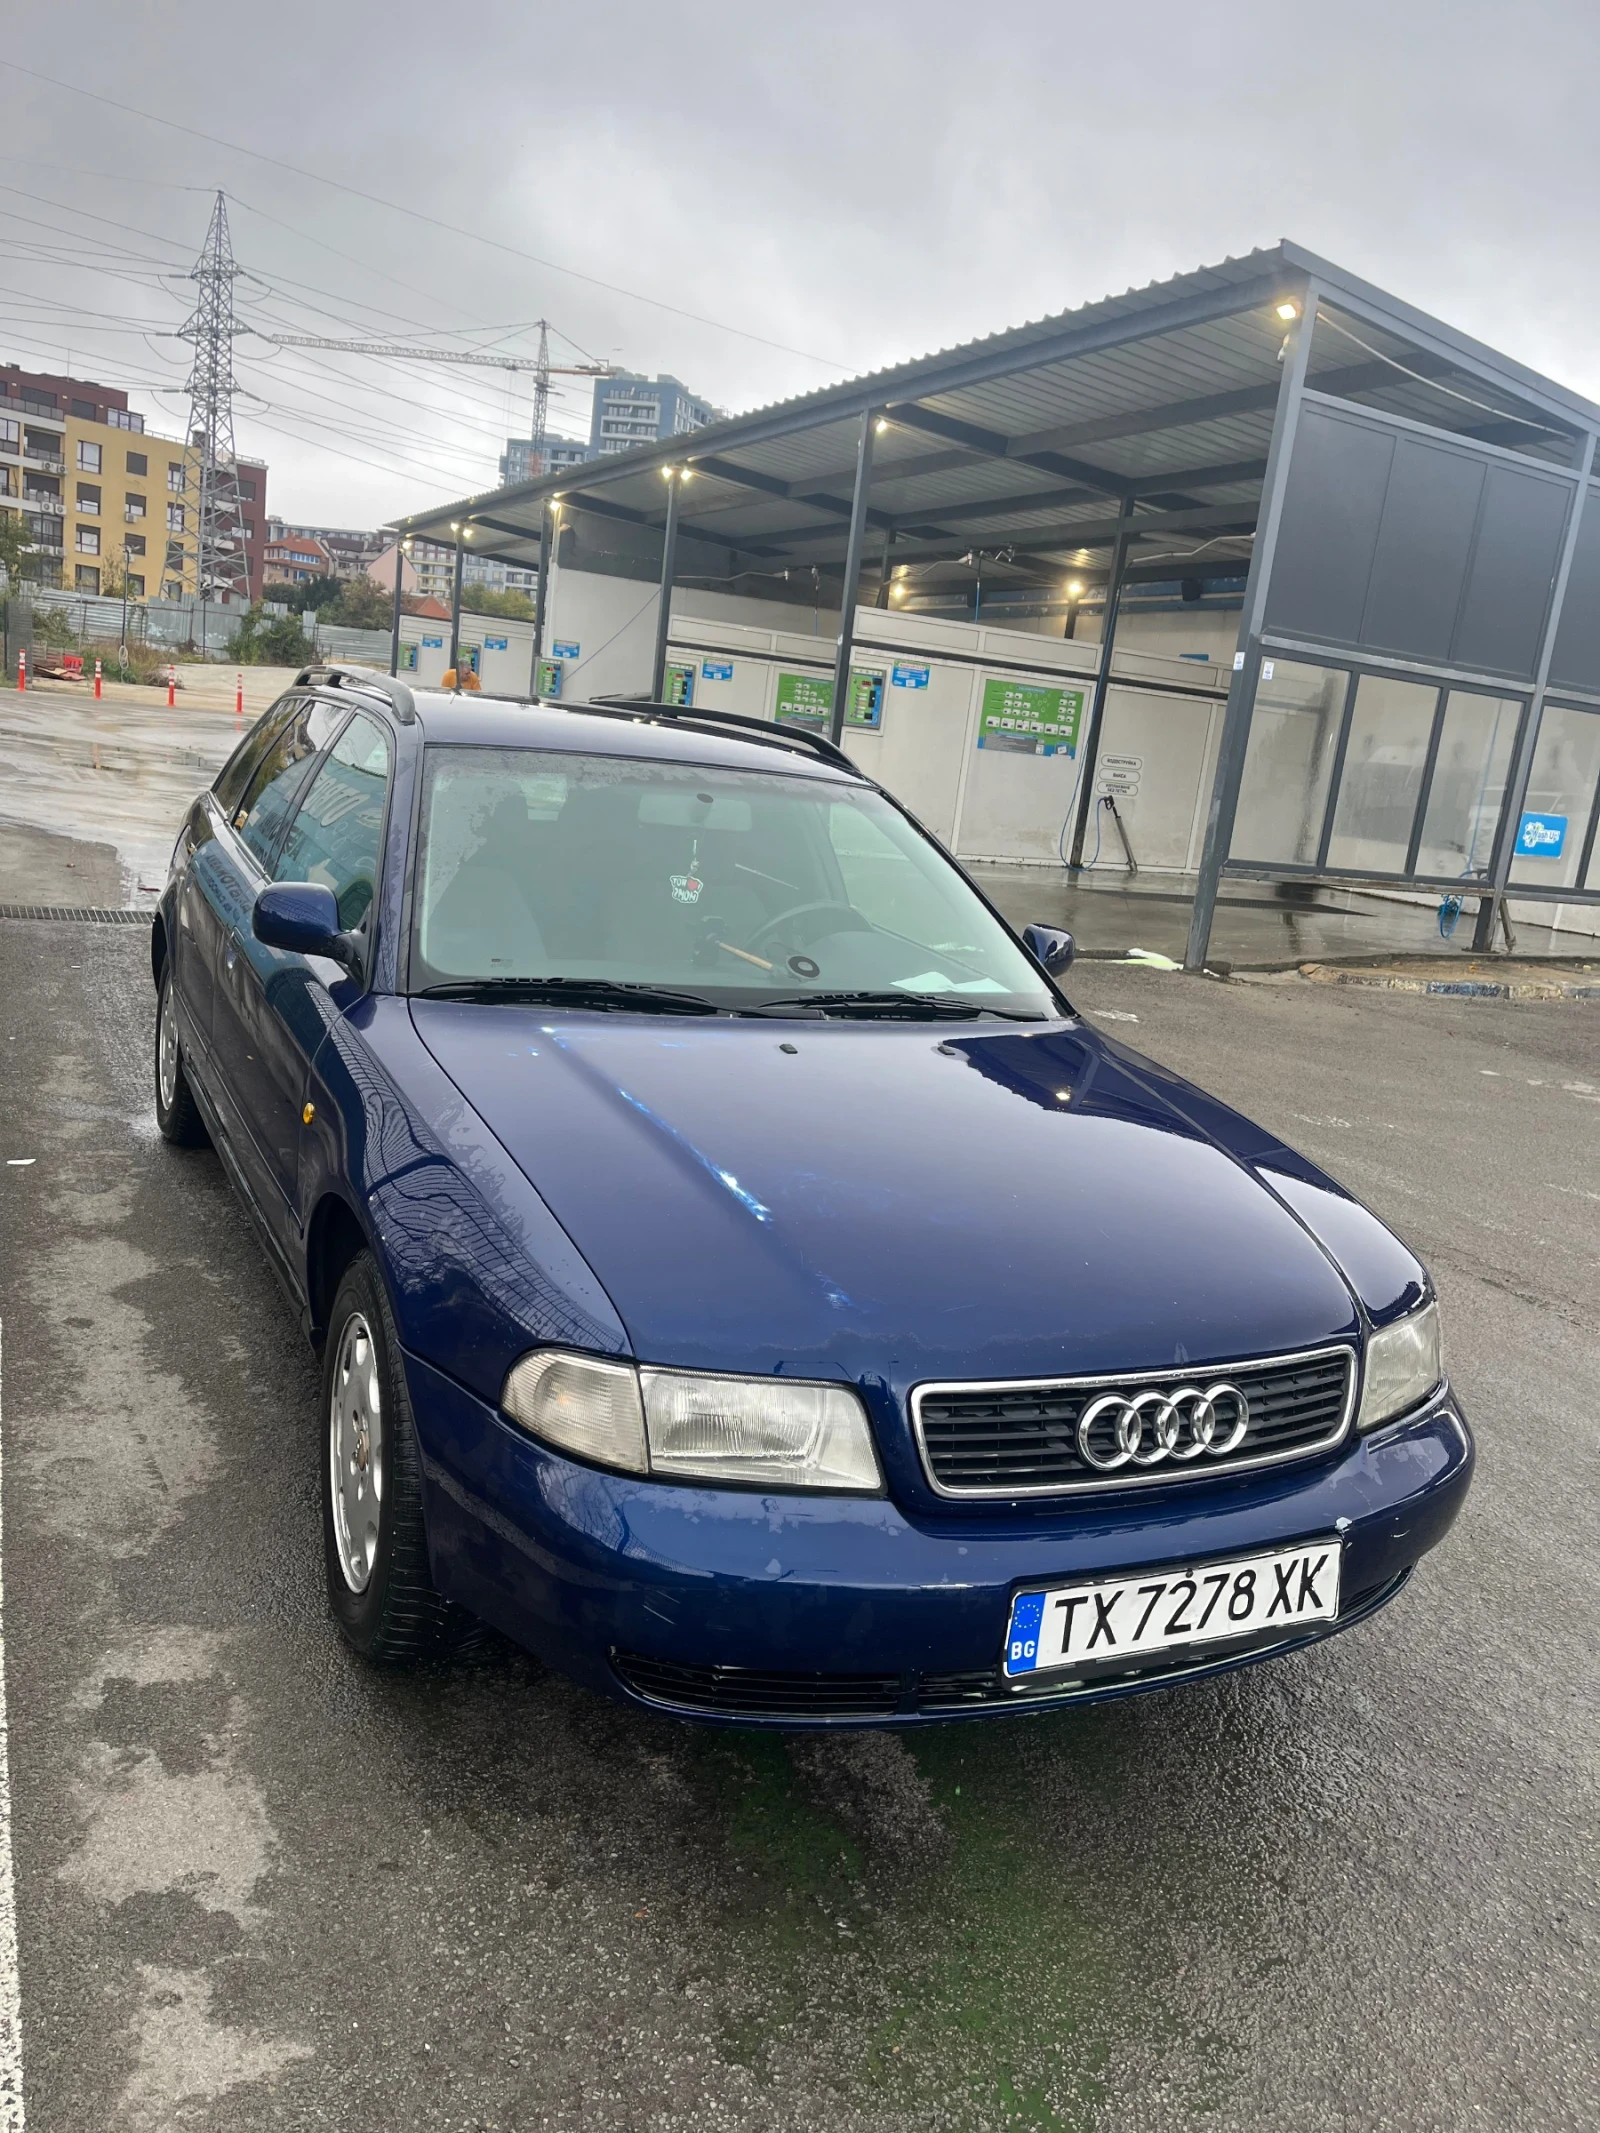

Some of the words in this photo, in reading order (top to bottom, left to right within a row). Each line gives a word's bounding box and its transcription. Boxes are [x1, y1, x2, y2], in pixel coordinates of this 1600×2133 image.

[1532, 829, 1548, 838] Wash
[1550, 831, 1558, 840] Up
[1055, 1590, 1124, 1654] TX
[1132, 1569, 1257, 1641] 7278
[1266, 1554, 1329, 1618] XK
[1011, 1640, 1035, 1660] BG
